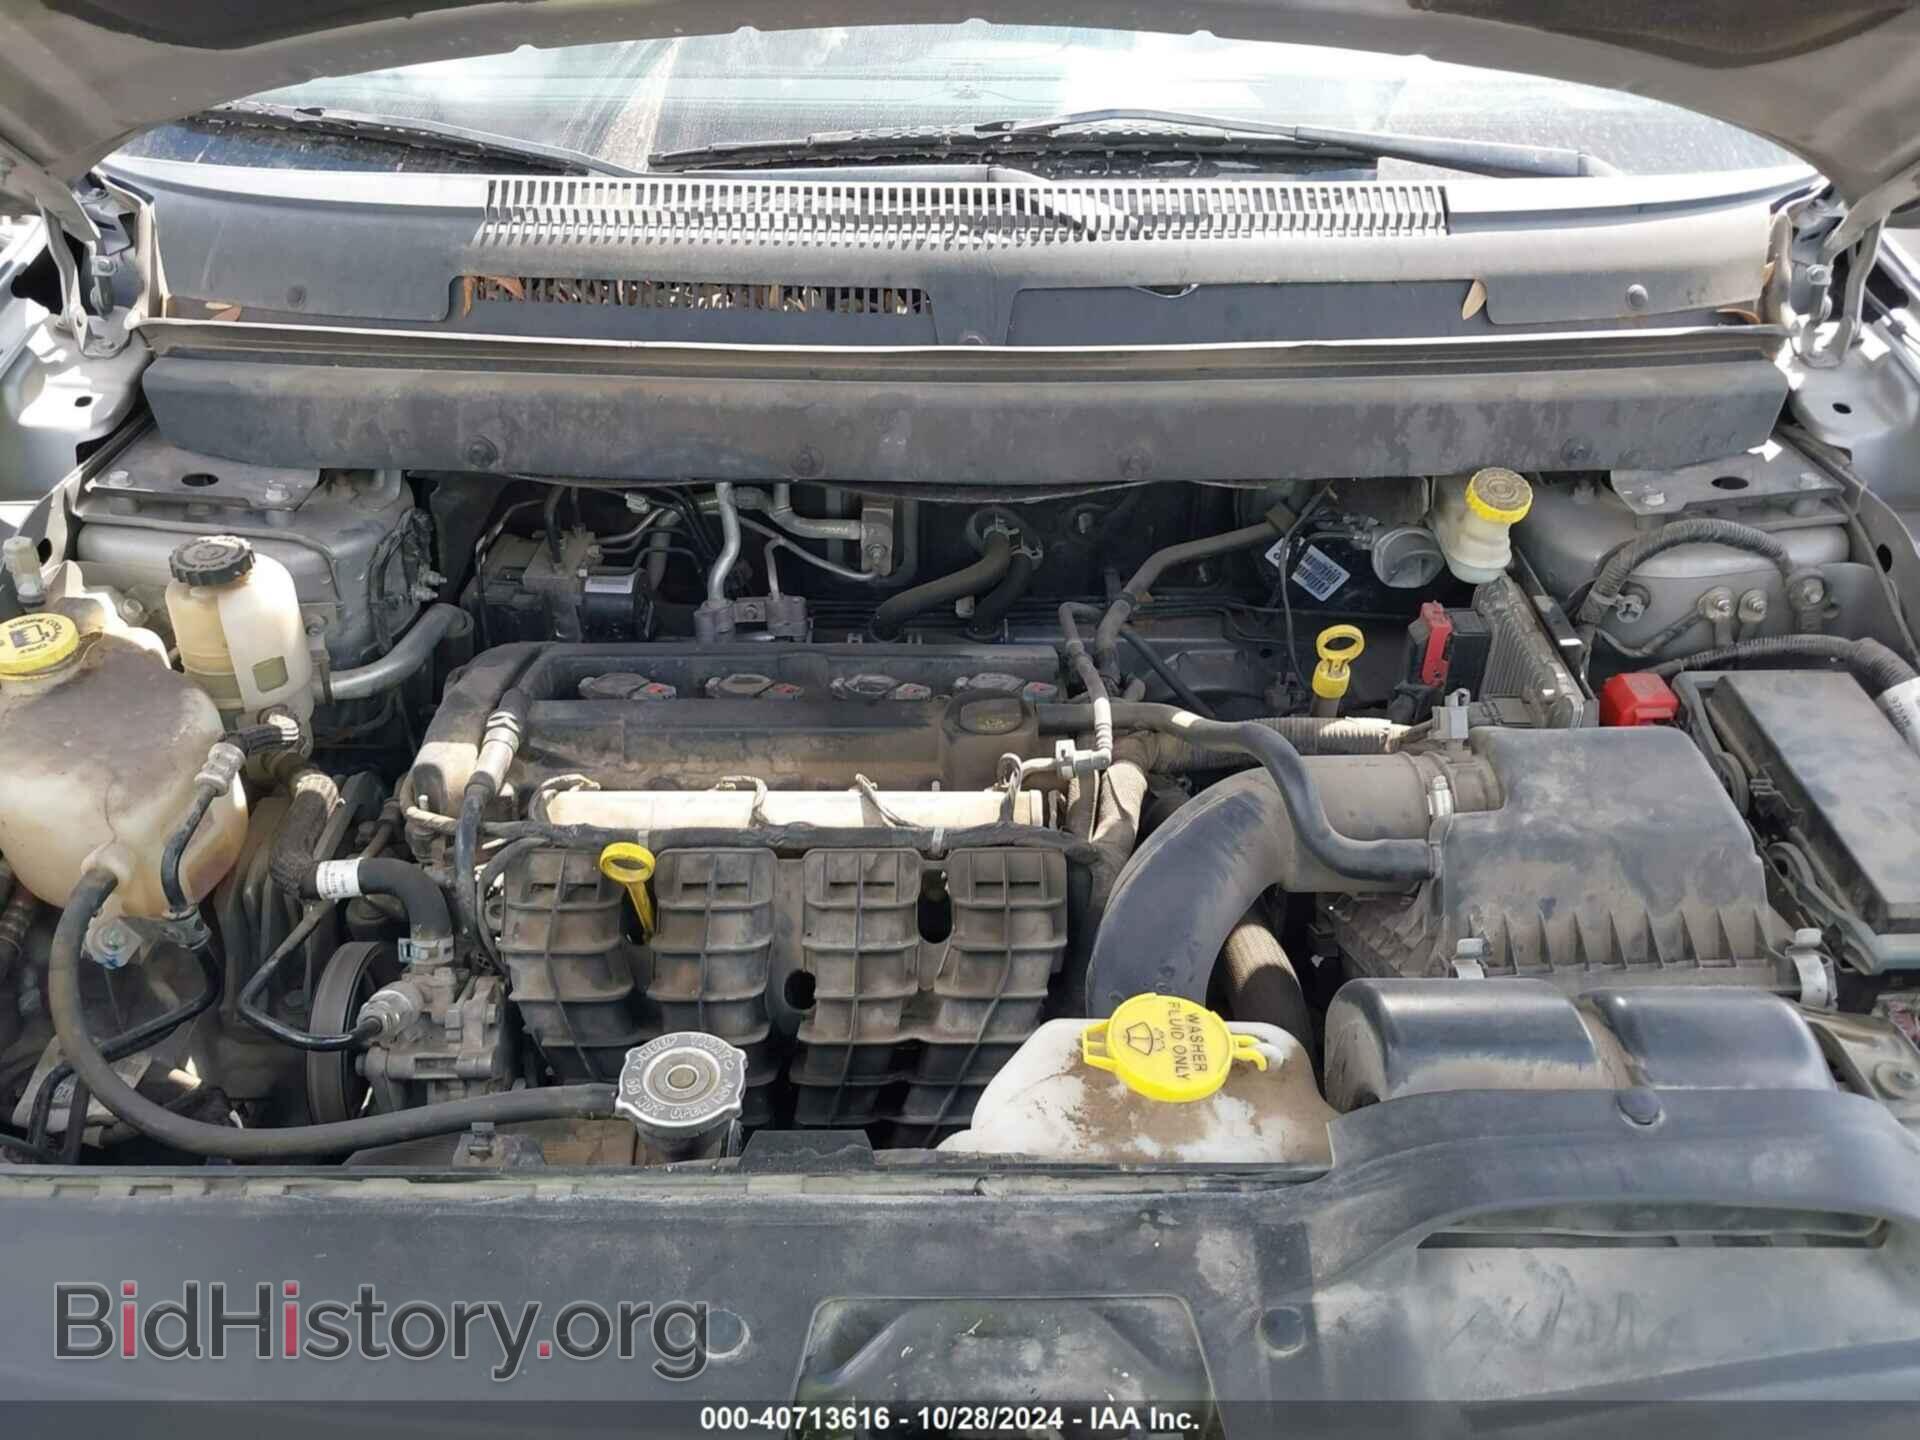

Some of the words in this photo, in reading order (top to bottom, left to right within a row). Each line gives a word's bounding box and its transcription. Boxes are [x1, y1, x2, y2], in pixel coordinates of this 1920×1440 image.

[1168, 1001, 1185, 1041] FLUID
[1185, 1012, 1208, 1072] WASHER
[1172, 1044, 1192, 1081] ONLY
